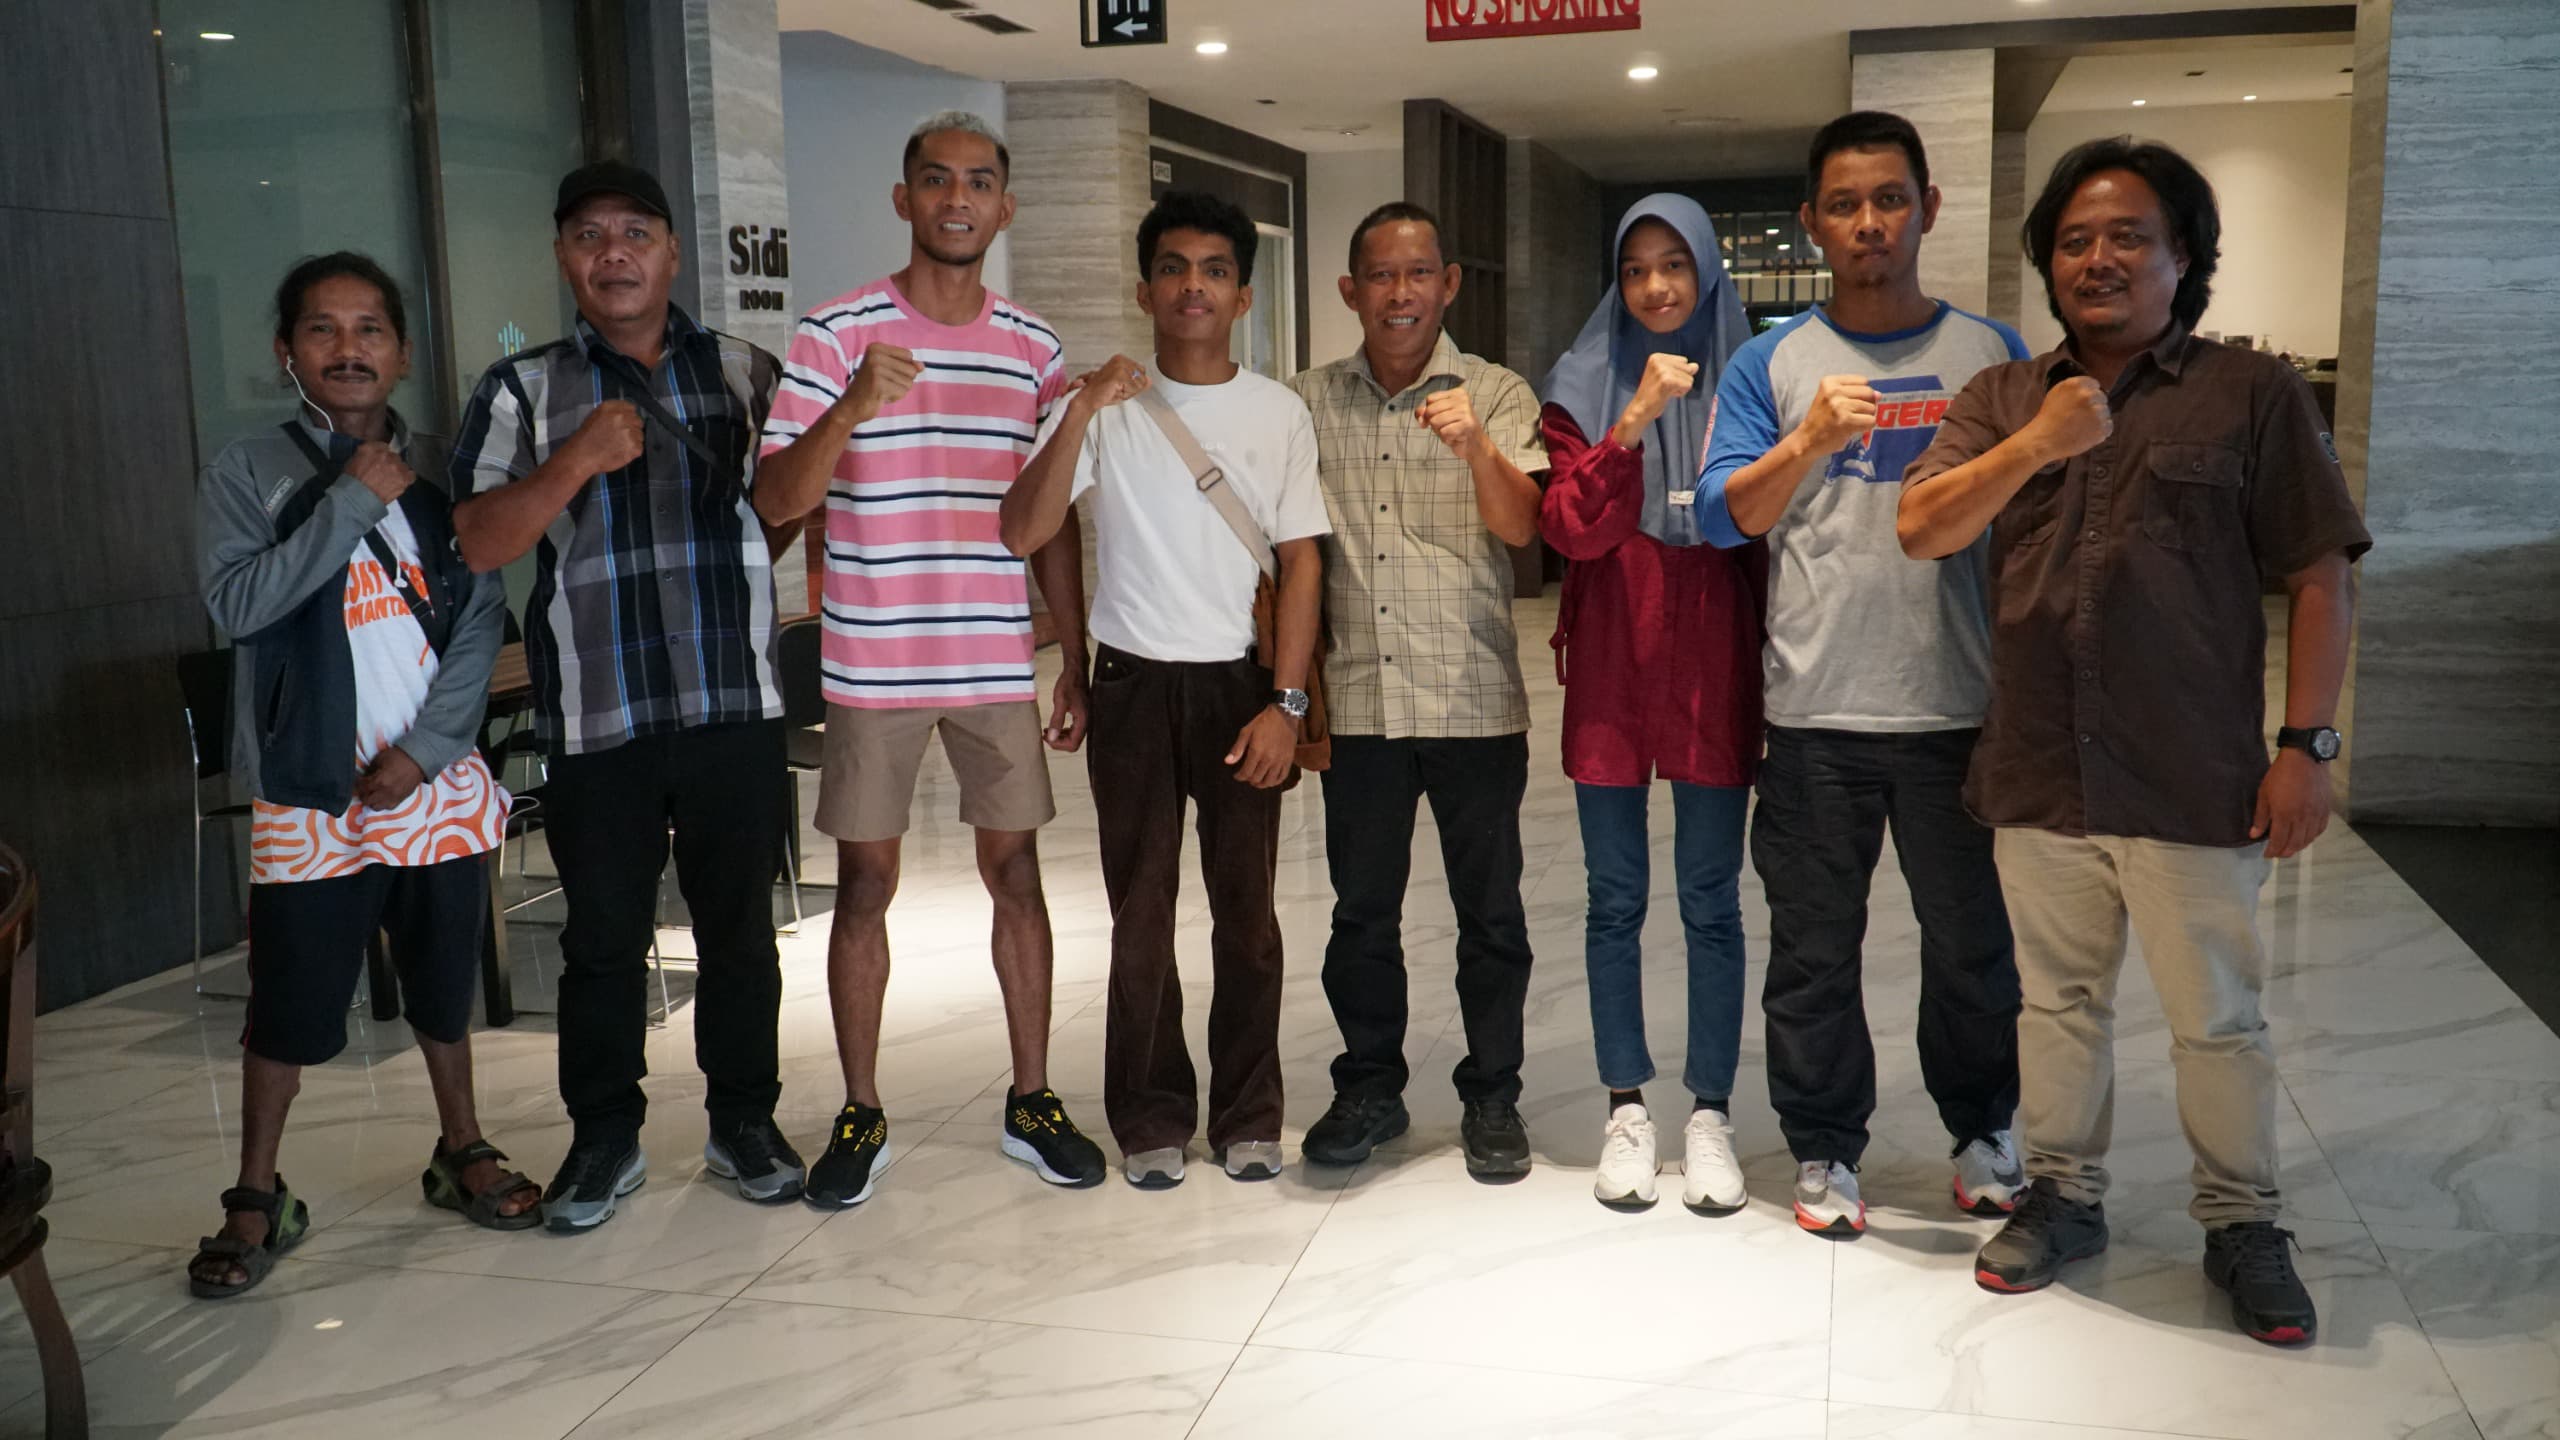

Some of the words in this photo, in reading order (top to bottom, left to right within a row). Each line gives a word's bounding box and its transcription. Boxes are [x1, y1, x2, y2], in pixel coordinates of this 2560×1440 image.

[729, 225, 788, 278] Sidi
[740, 289, 783, 311] ROOM
[1875, 399, 1954, 428] GER
